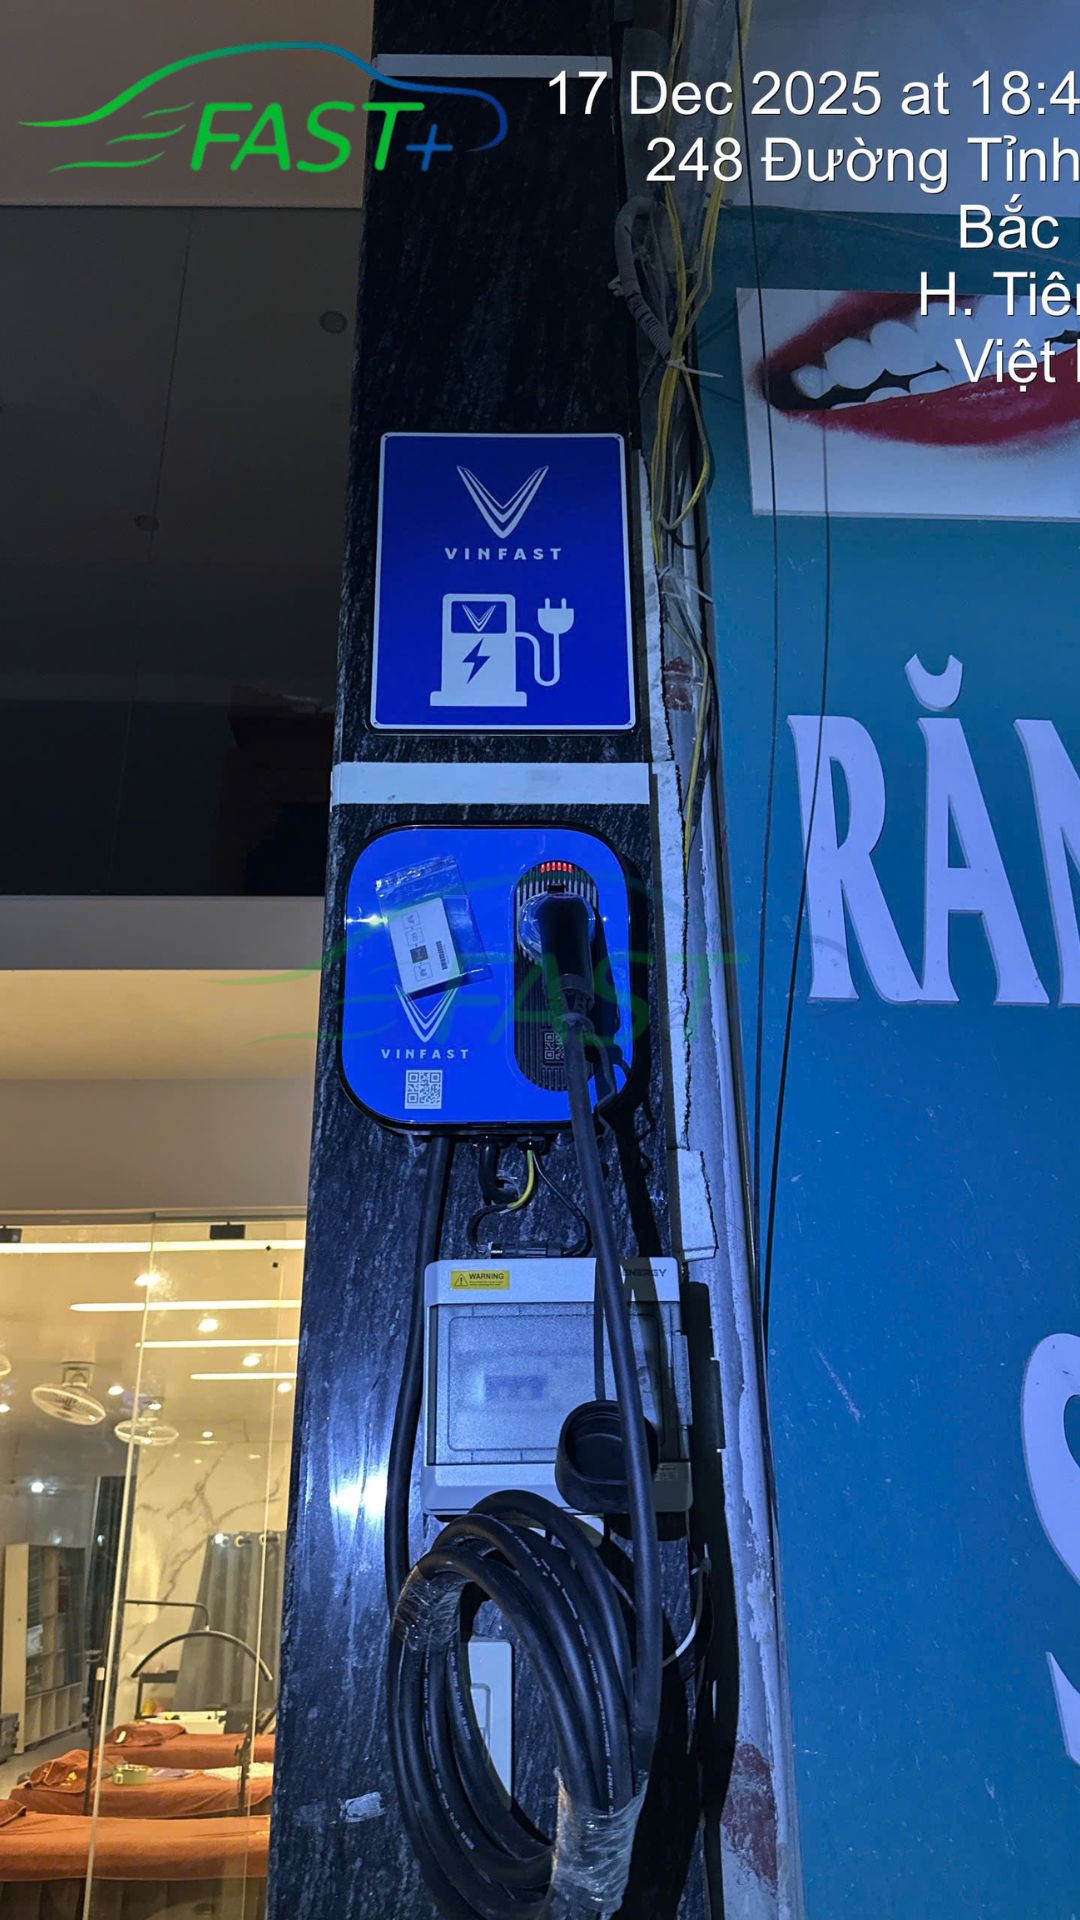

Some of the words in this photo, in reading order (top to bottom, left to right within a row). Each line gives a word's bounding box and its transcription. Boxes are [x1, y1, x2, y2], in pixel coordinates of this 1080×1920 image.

[444, 547, 563, 562] VINFAST
[380, 1048, 469, 1060] VINFAST
[468, 1272, 504, 1280] WARNING
